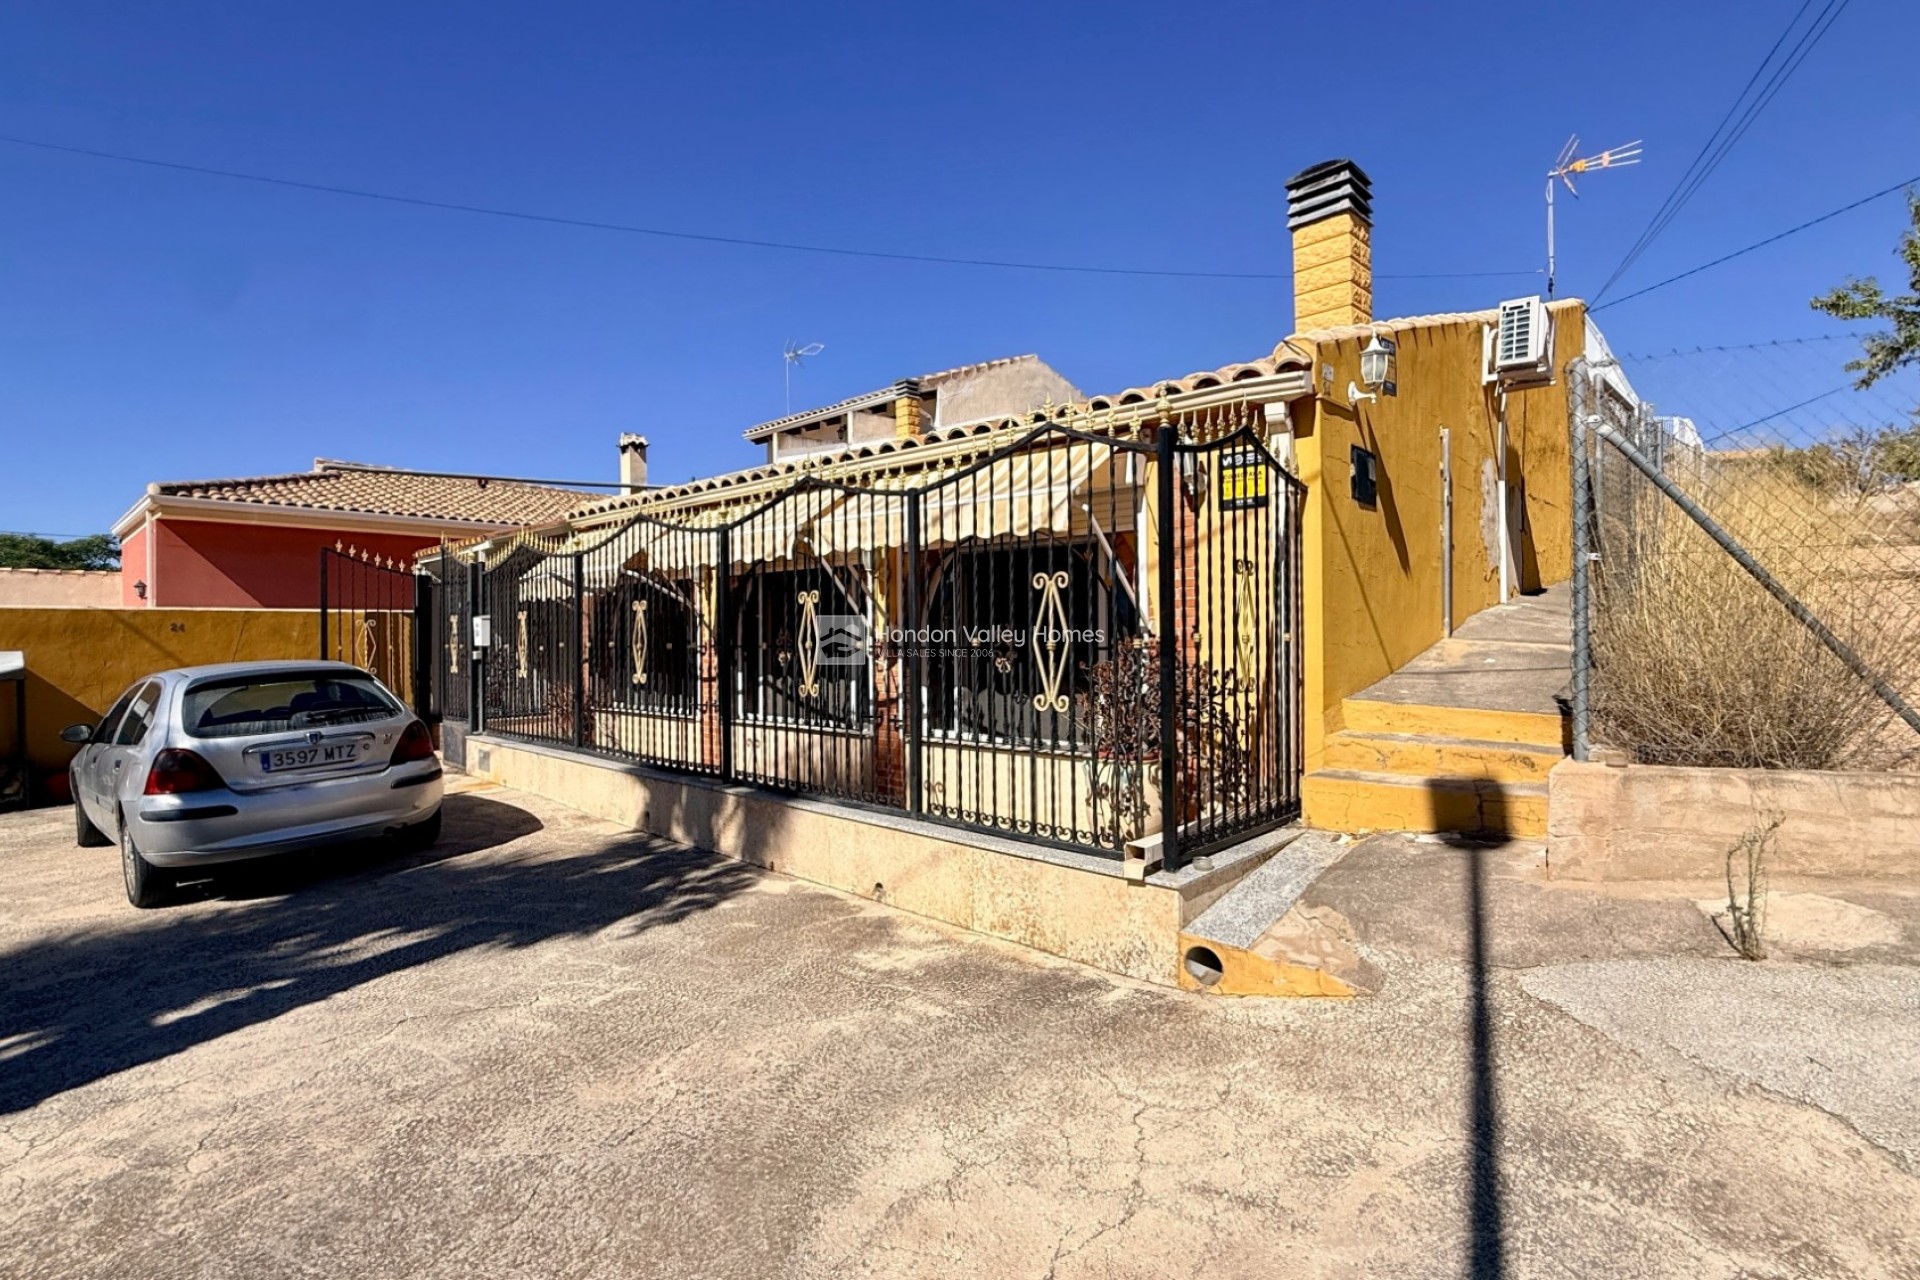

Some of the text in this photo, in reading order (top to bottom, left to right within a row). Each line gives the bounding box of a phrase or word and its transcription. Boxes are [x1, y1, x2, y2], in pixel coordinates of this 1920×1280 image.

[170, 622, 186, 633] 24
[273, 749, 318, 767] 3597
[324, 744, 356, 761] MTZ
